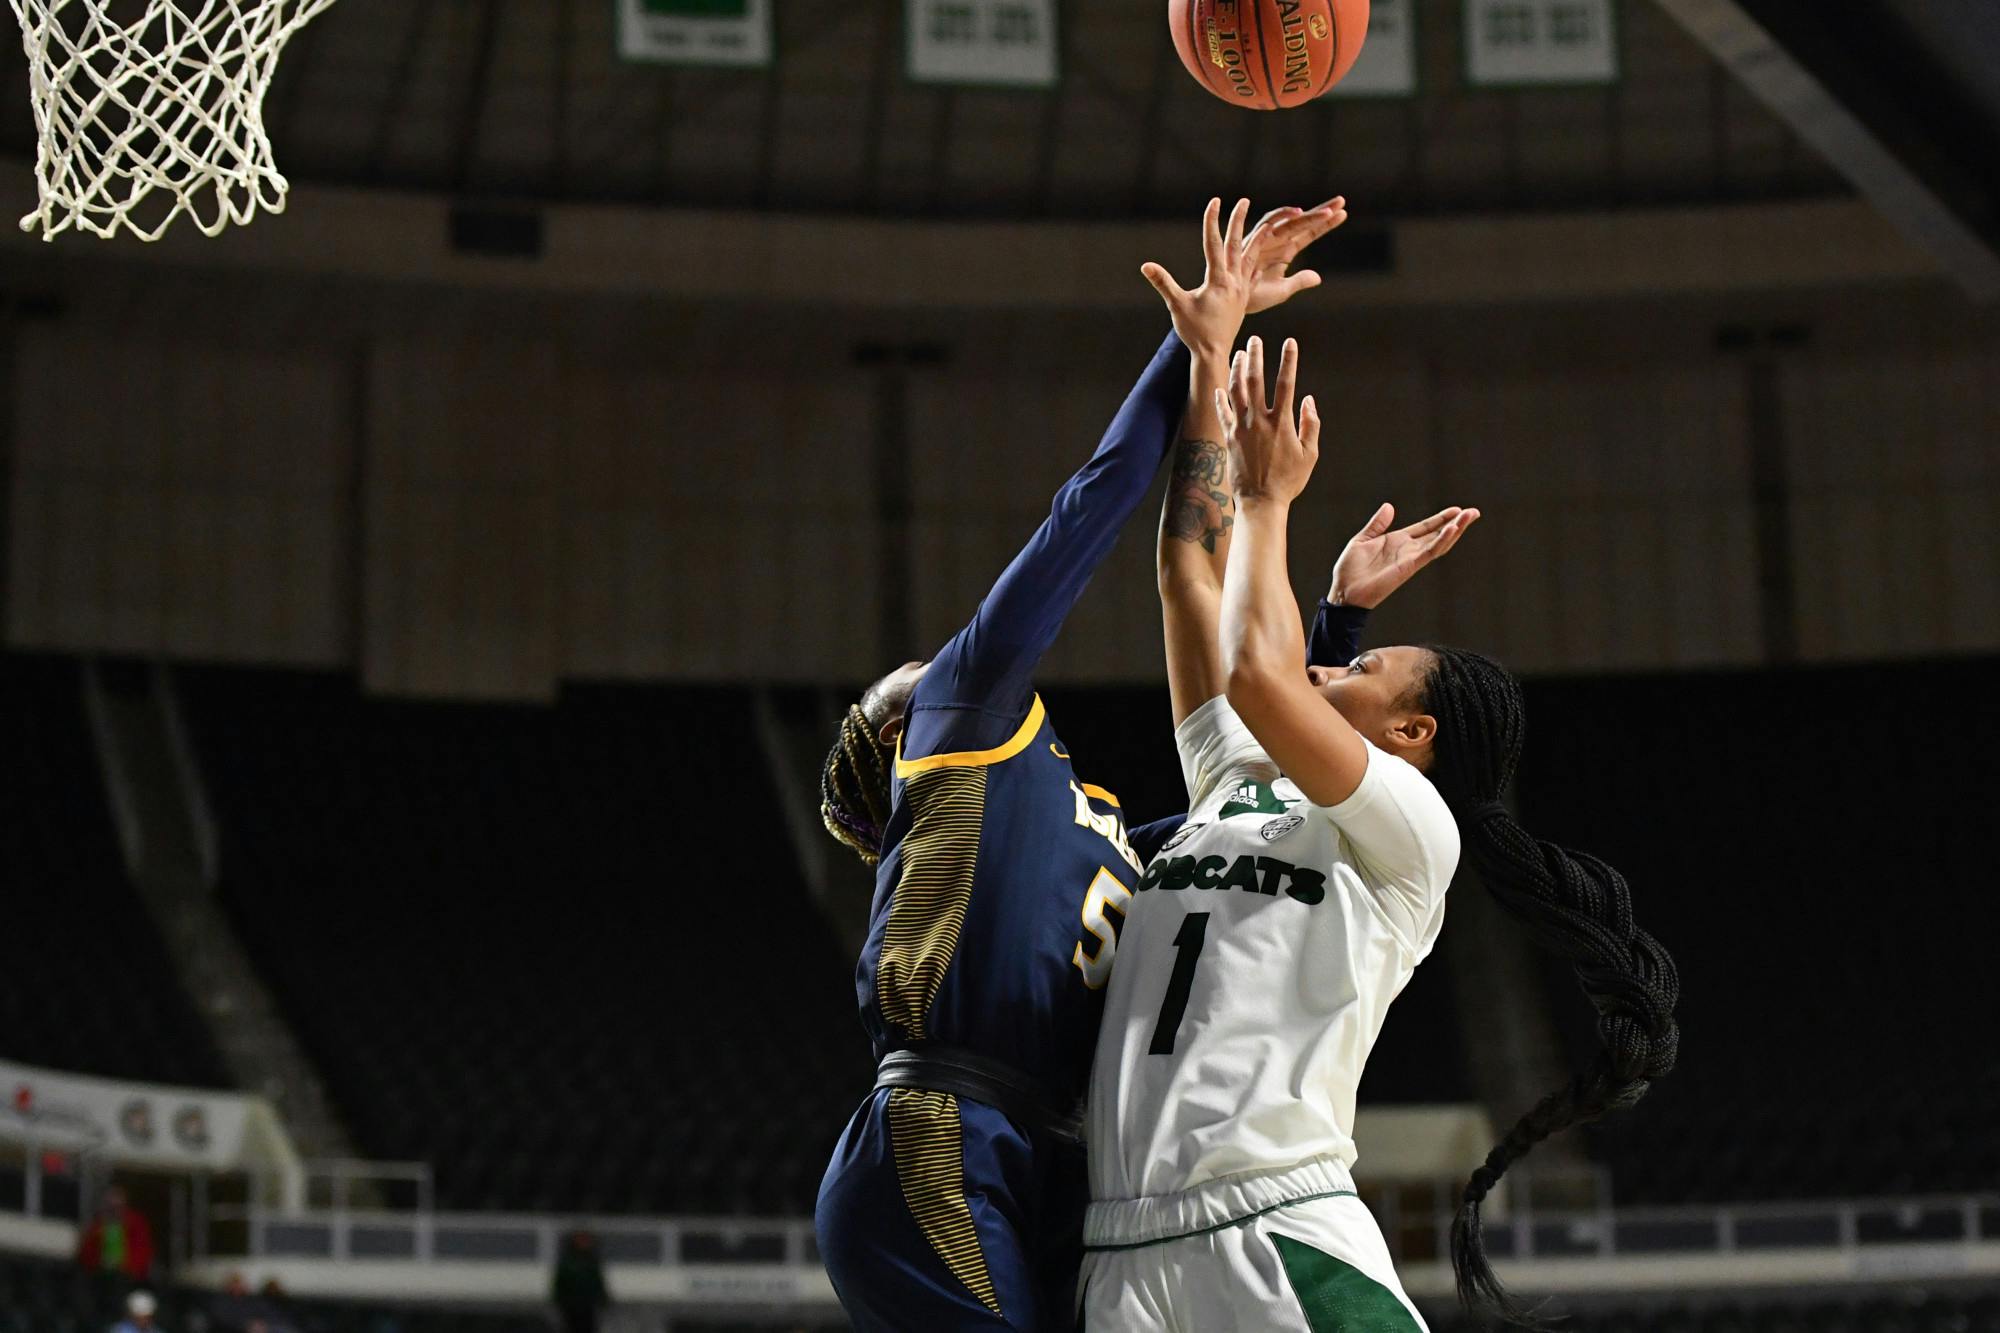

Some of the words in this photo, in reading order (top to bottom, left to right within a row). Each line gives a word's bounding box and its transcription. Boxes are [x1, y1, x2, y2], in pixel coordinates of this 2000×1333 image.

[1218, 0, 1256, 97] F-1000
[1275, 0, 1312, 94] ALDING
[1229, 794, 1260, 809] didas
[1072, 865, 1134, 990] 5
[1136, 854, 1327, 906] OBCATS
[1148, 912, 1211, 1056] 1
